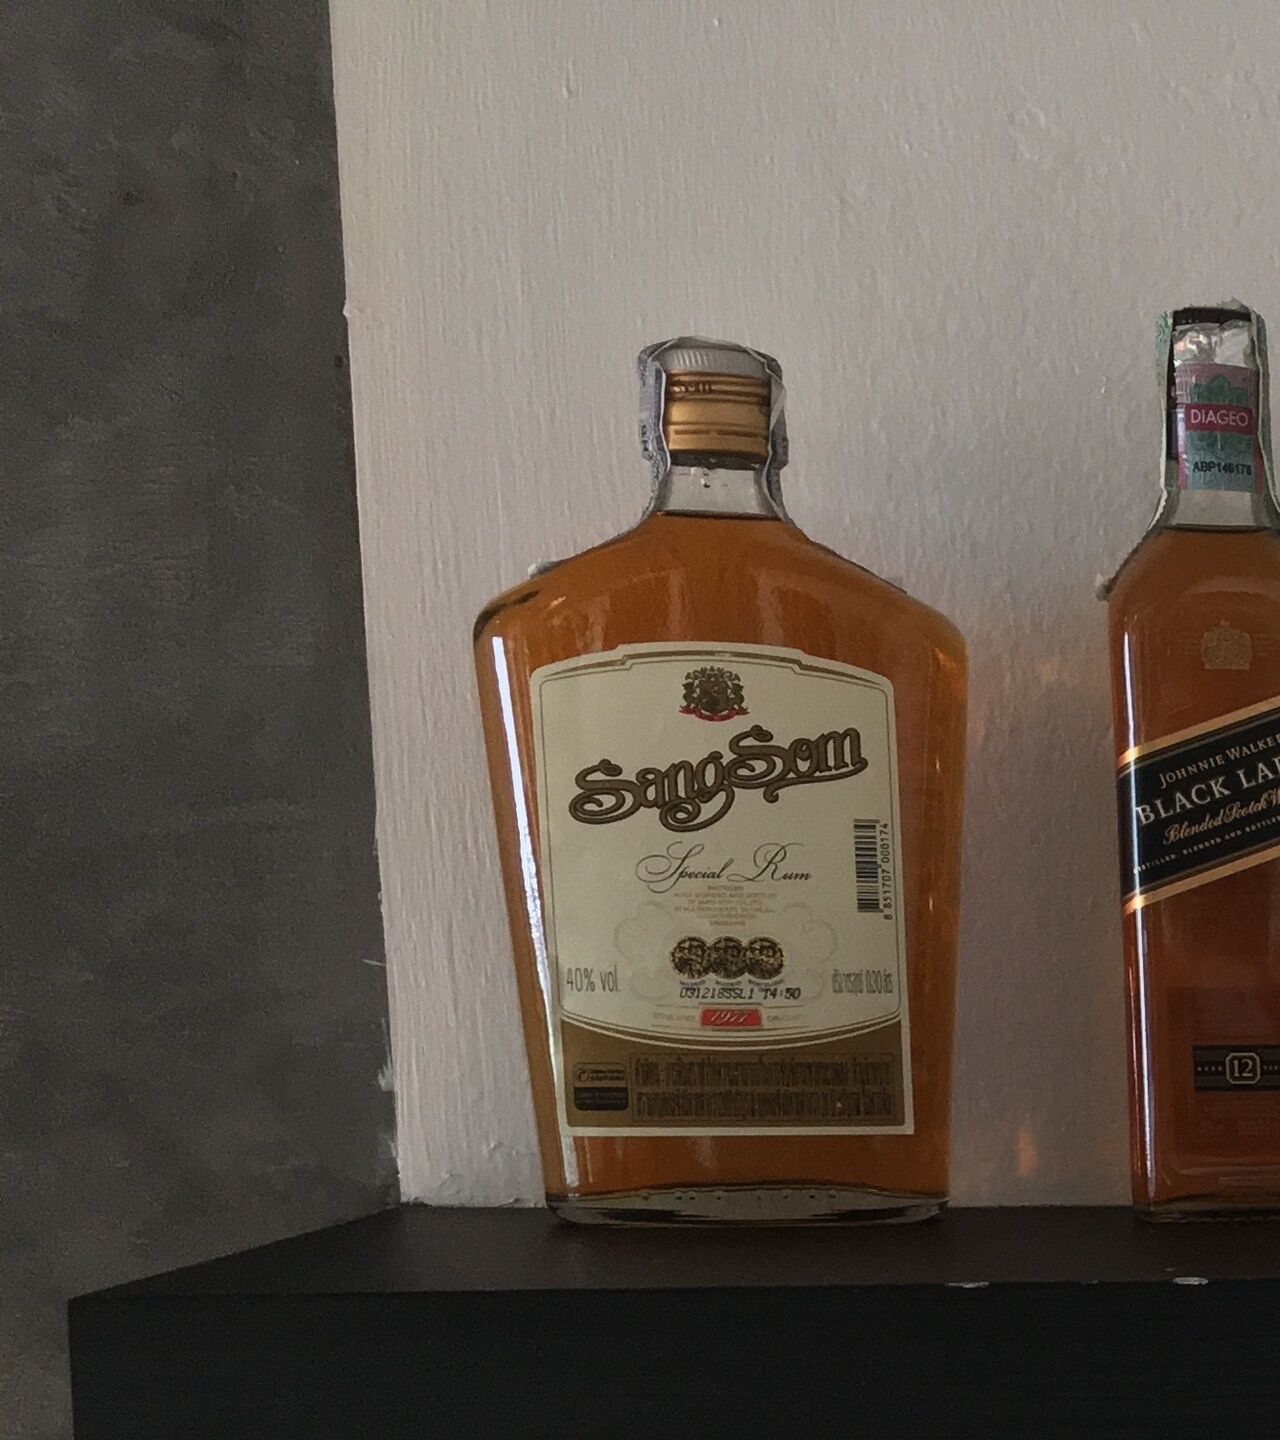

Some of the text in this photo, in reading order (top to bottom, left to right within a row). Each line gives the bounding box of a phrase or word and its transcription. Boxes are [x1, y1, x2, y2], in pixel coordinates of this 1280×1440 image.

[1190, 408, 1249, 427] DIAGEO
[568, 724, 869, 833] SangSom
[1160, 755, 1225, 788] JOHNNIE
[1135, 777, 1233, 827] BLACK
[1162, 811, 1224, 846] Blended
[1222, 794, 1268, 822] Scotch
[635, 841, 812, 894] Special Rum
[565, 966, 595, 993] 40%
[709, 1009, 749, 1026] 1977
[1232, 1058, 1253, 1078] 12
